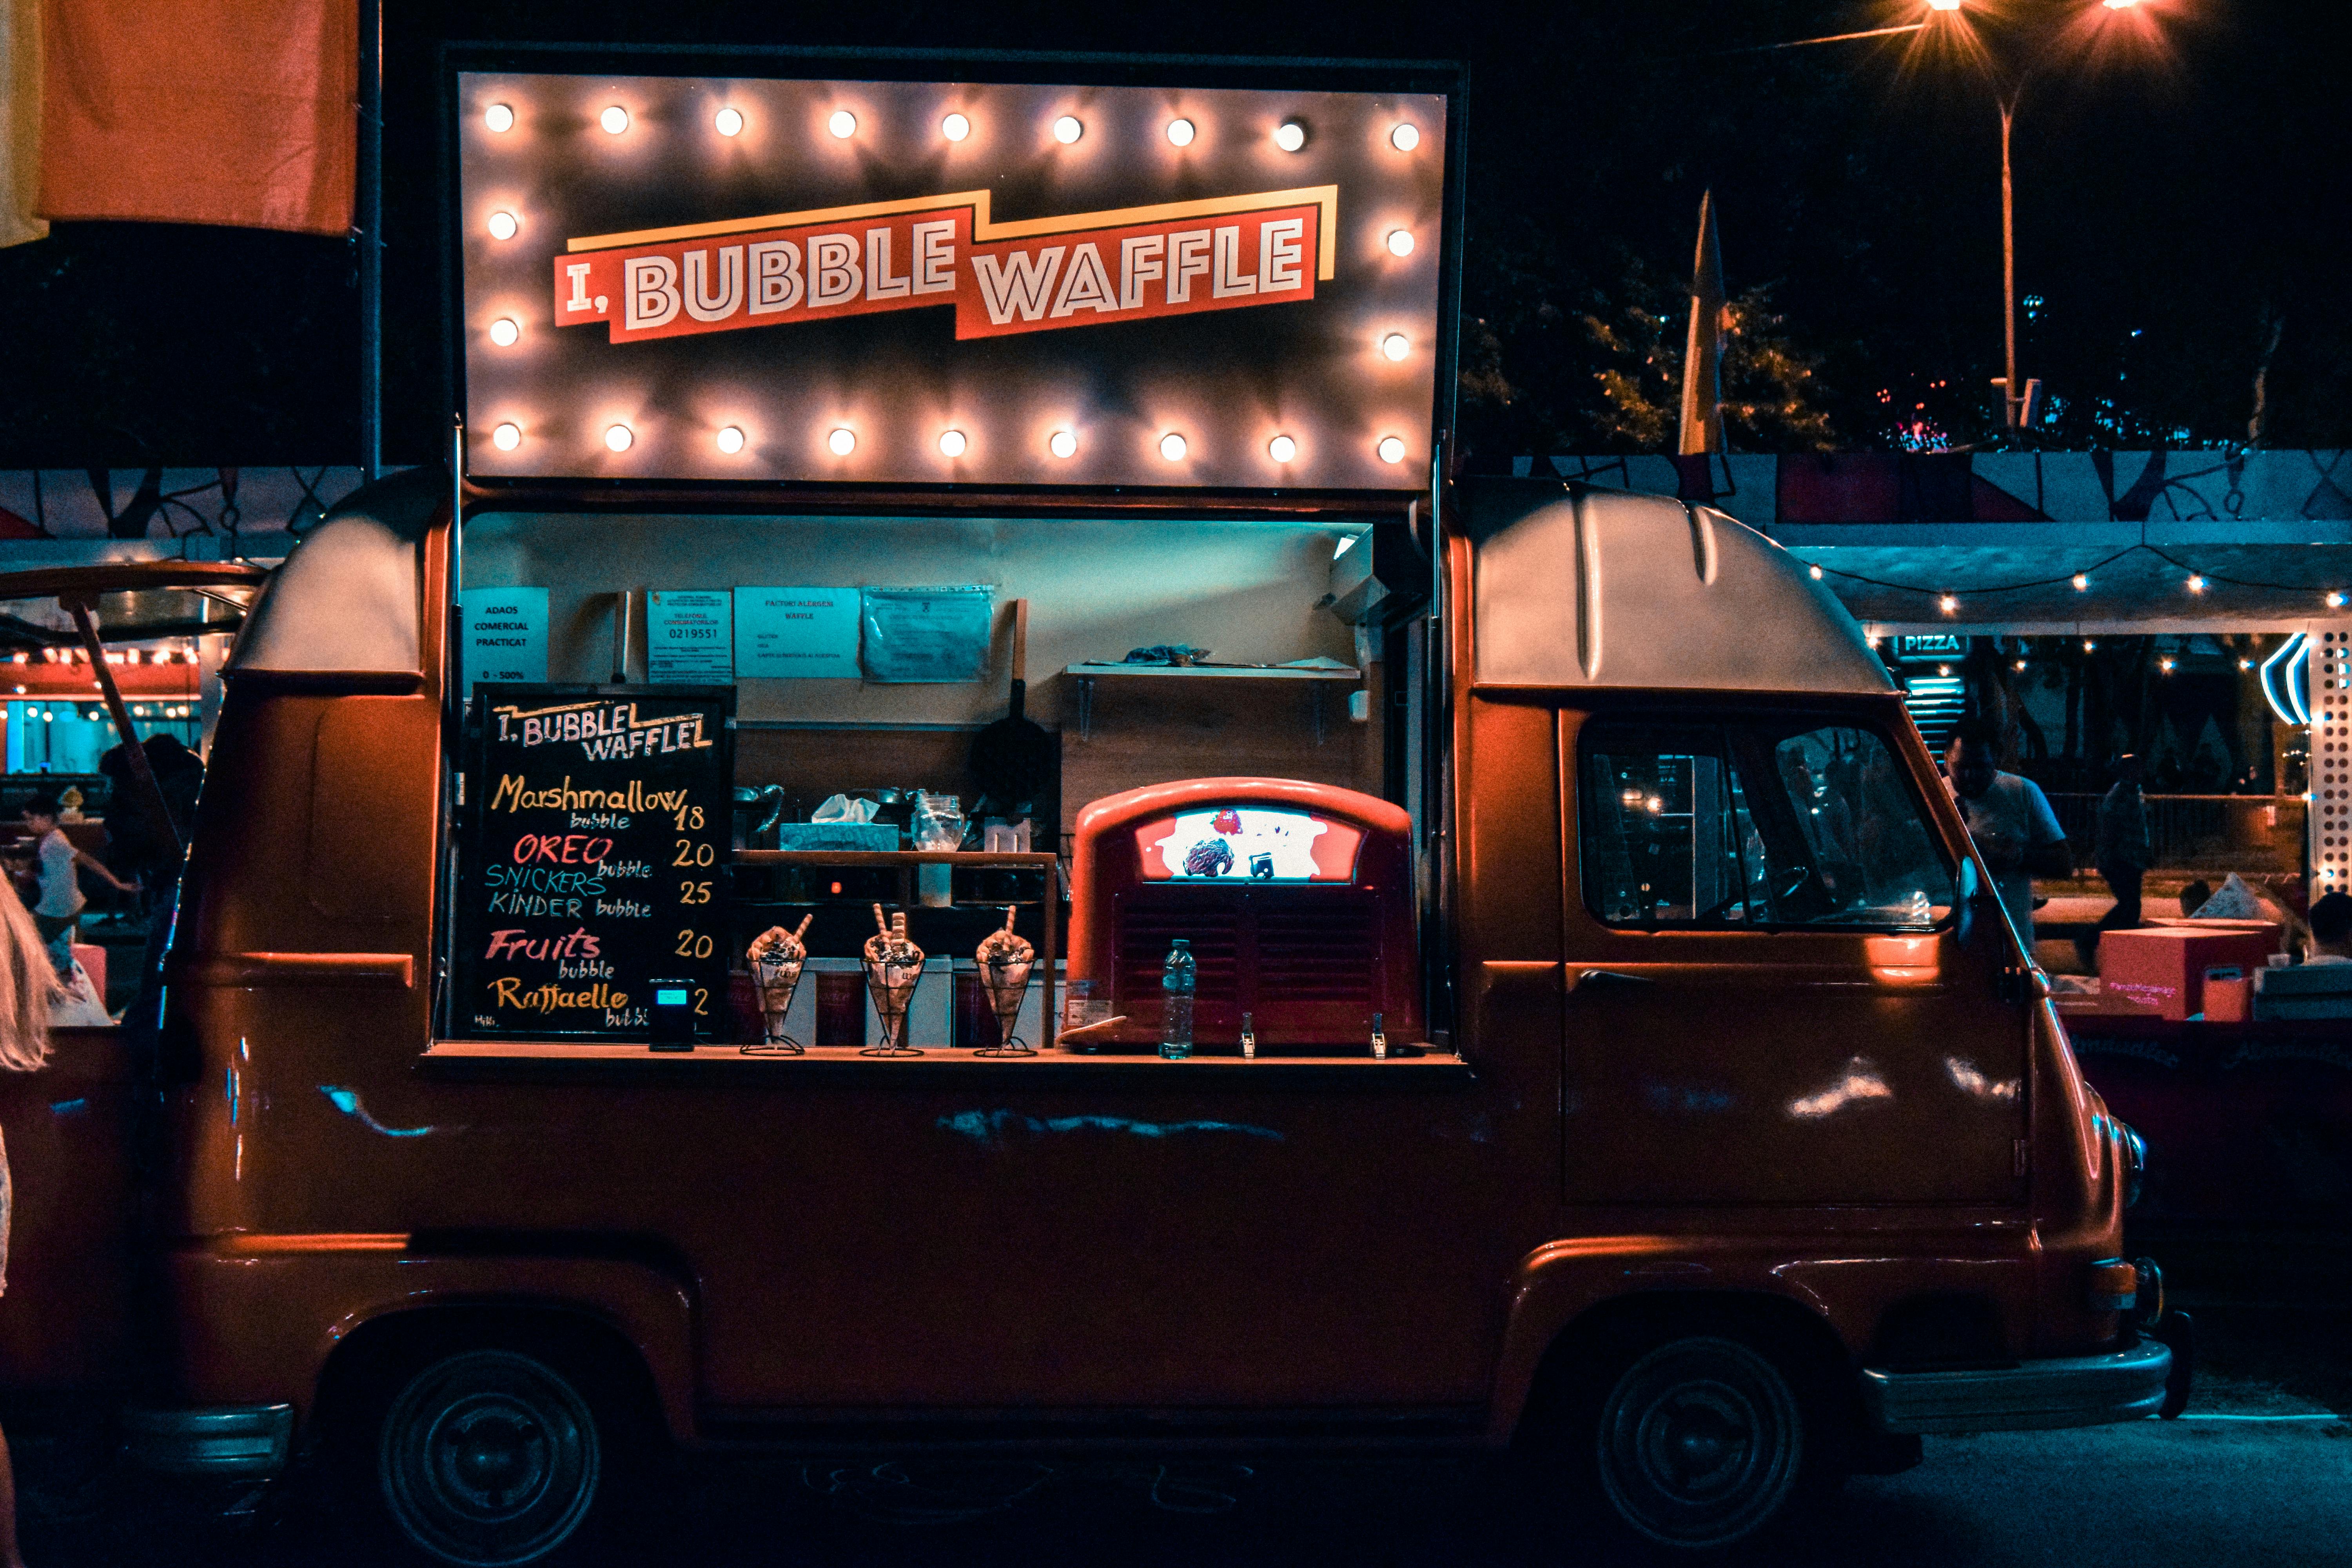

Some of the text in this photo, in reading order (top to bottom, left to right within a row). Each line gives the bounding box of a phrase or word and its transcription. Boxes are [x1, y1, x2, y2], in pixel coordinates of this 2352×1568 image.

[566, 218, 1304, 330] I, BUBBLE WAFFLE
[476, 638, 526, 646] PRACTICAT
[669, 629, 717, 639] 0219551
[1905, 635, 1959, 651] PIZZA
[523, 705, 628, 747] BUBBLE
[581, 722, 696, 761] WAFFLE
[491, 773, 688, 813] Marshmallow
[570, 805, 704, 831] bubble 18
[513, 834, 714, 867] OREO 20
[597, 860, 652, 878] bubble
[679, 881, 713, 904] 25
[596, 898, 651, 918] bubble
[485, 926, 713, 961] Fruits 20
[559, 959, 615, 980] bubble
[487, 977, 628, 1015] Raffaello
